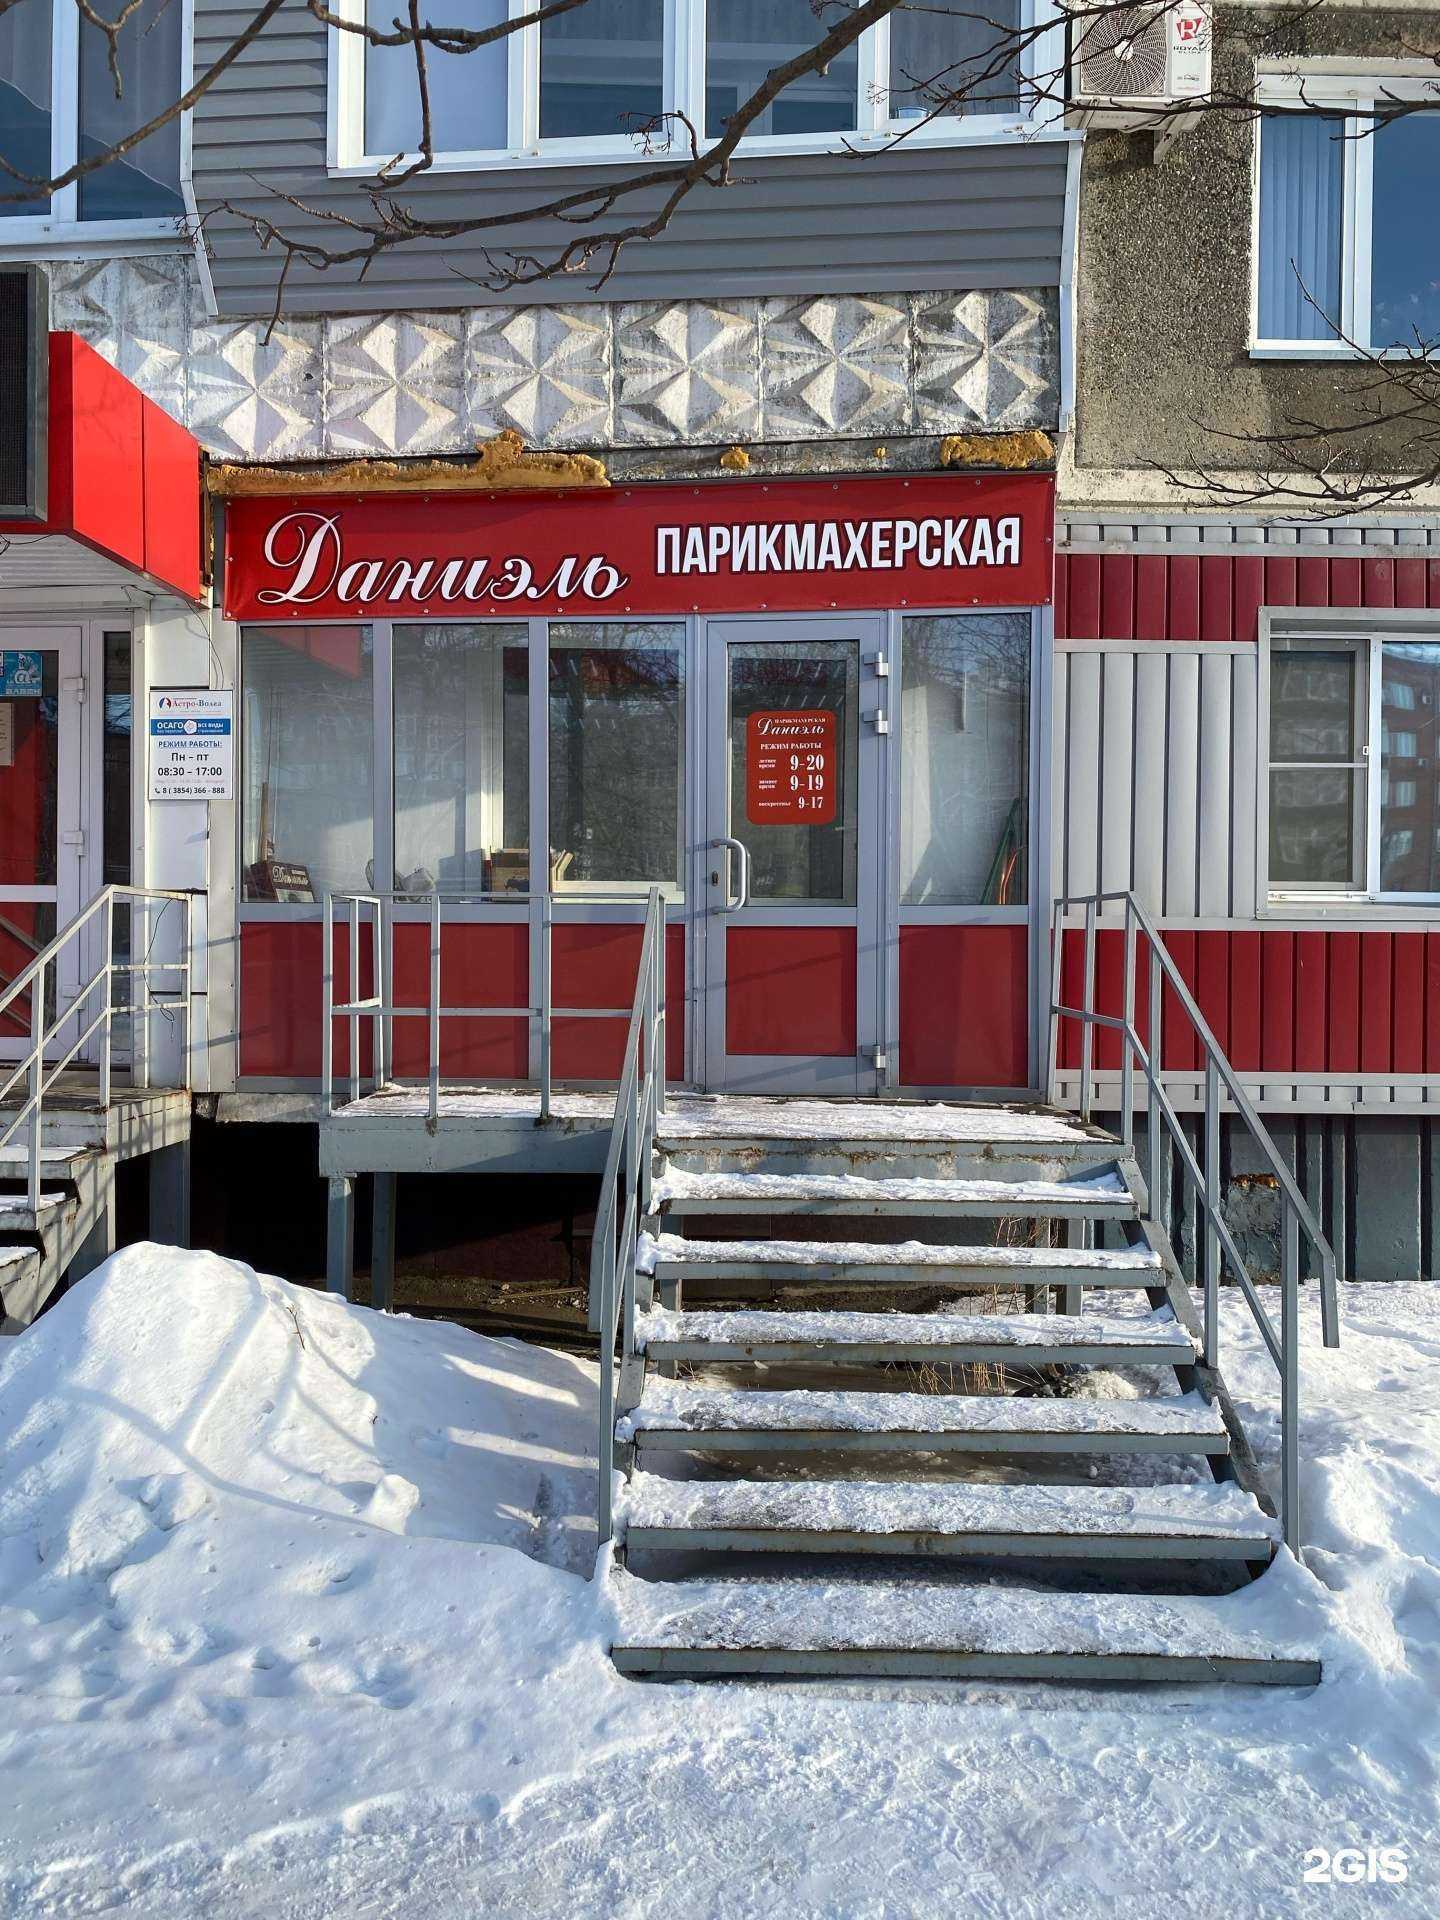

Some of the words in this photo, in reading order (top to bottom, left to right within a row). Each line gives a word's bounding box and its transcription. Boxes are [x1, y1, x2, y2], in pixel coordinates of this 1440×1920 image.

[258, 512, 628, 603] Даниэль
[657, 517, 1021, 574] ПАРИКМАХЕРСКАЯ
[757, 717, 825, 735] Даниэль
[158, 740, 188, 748] РЕЖИМ
[189, 740, 223, 748] РАБОТЫ:
[171, 753, 186, 761] Пн
[790, 754, 825, 771] 9-20
[157, 767, 185, 776] 08:30
[195, 767, 222, 776] 17:00
[790, 774, 824, 791] 9-19
[798, 796, 824, 809] 9-17
